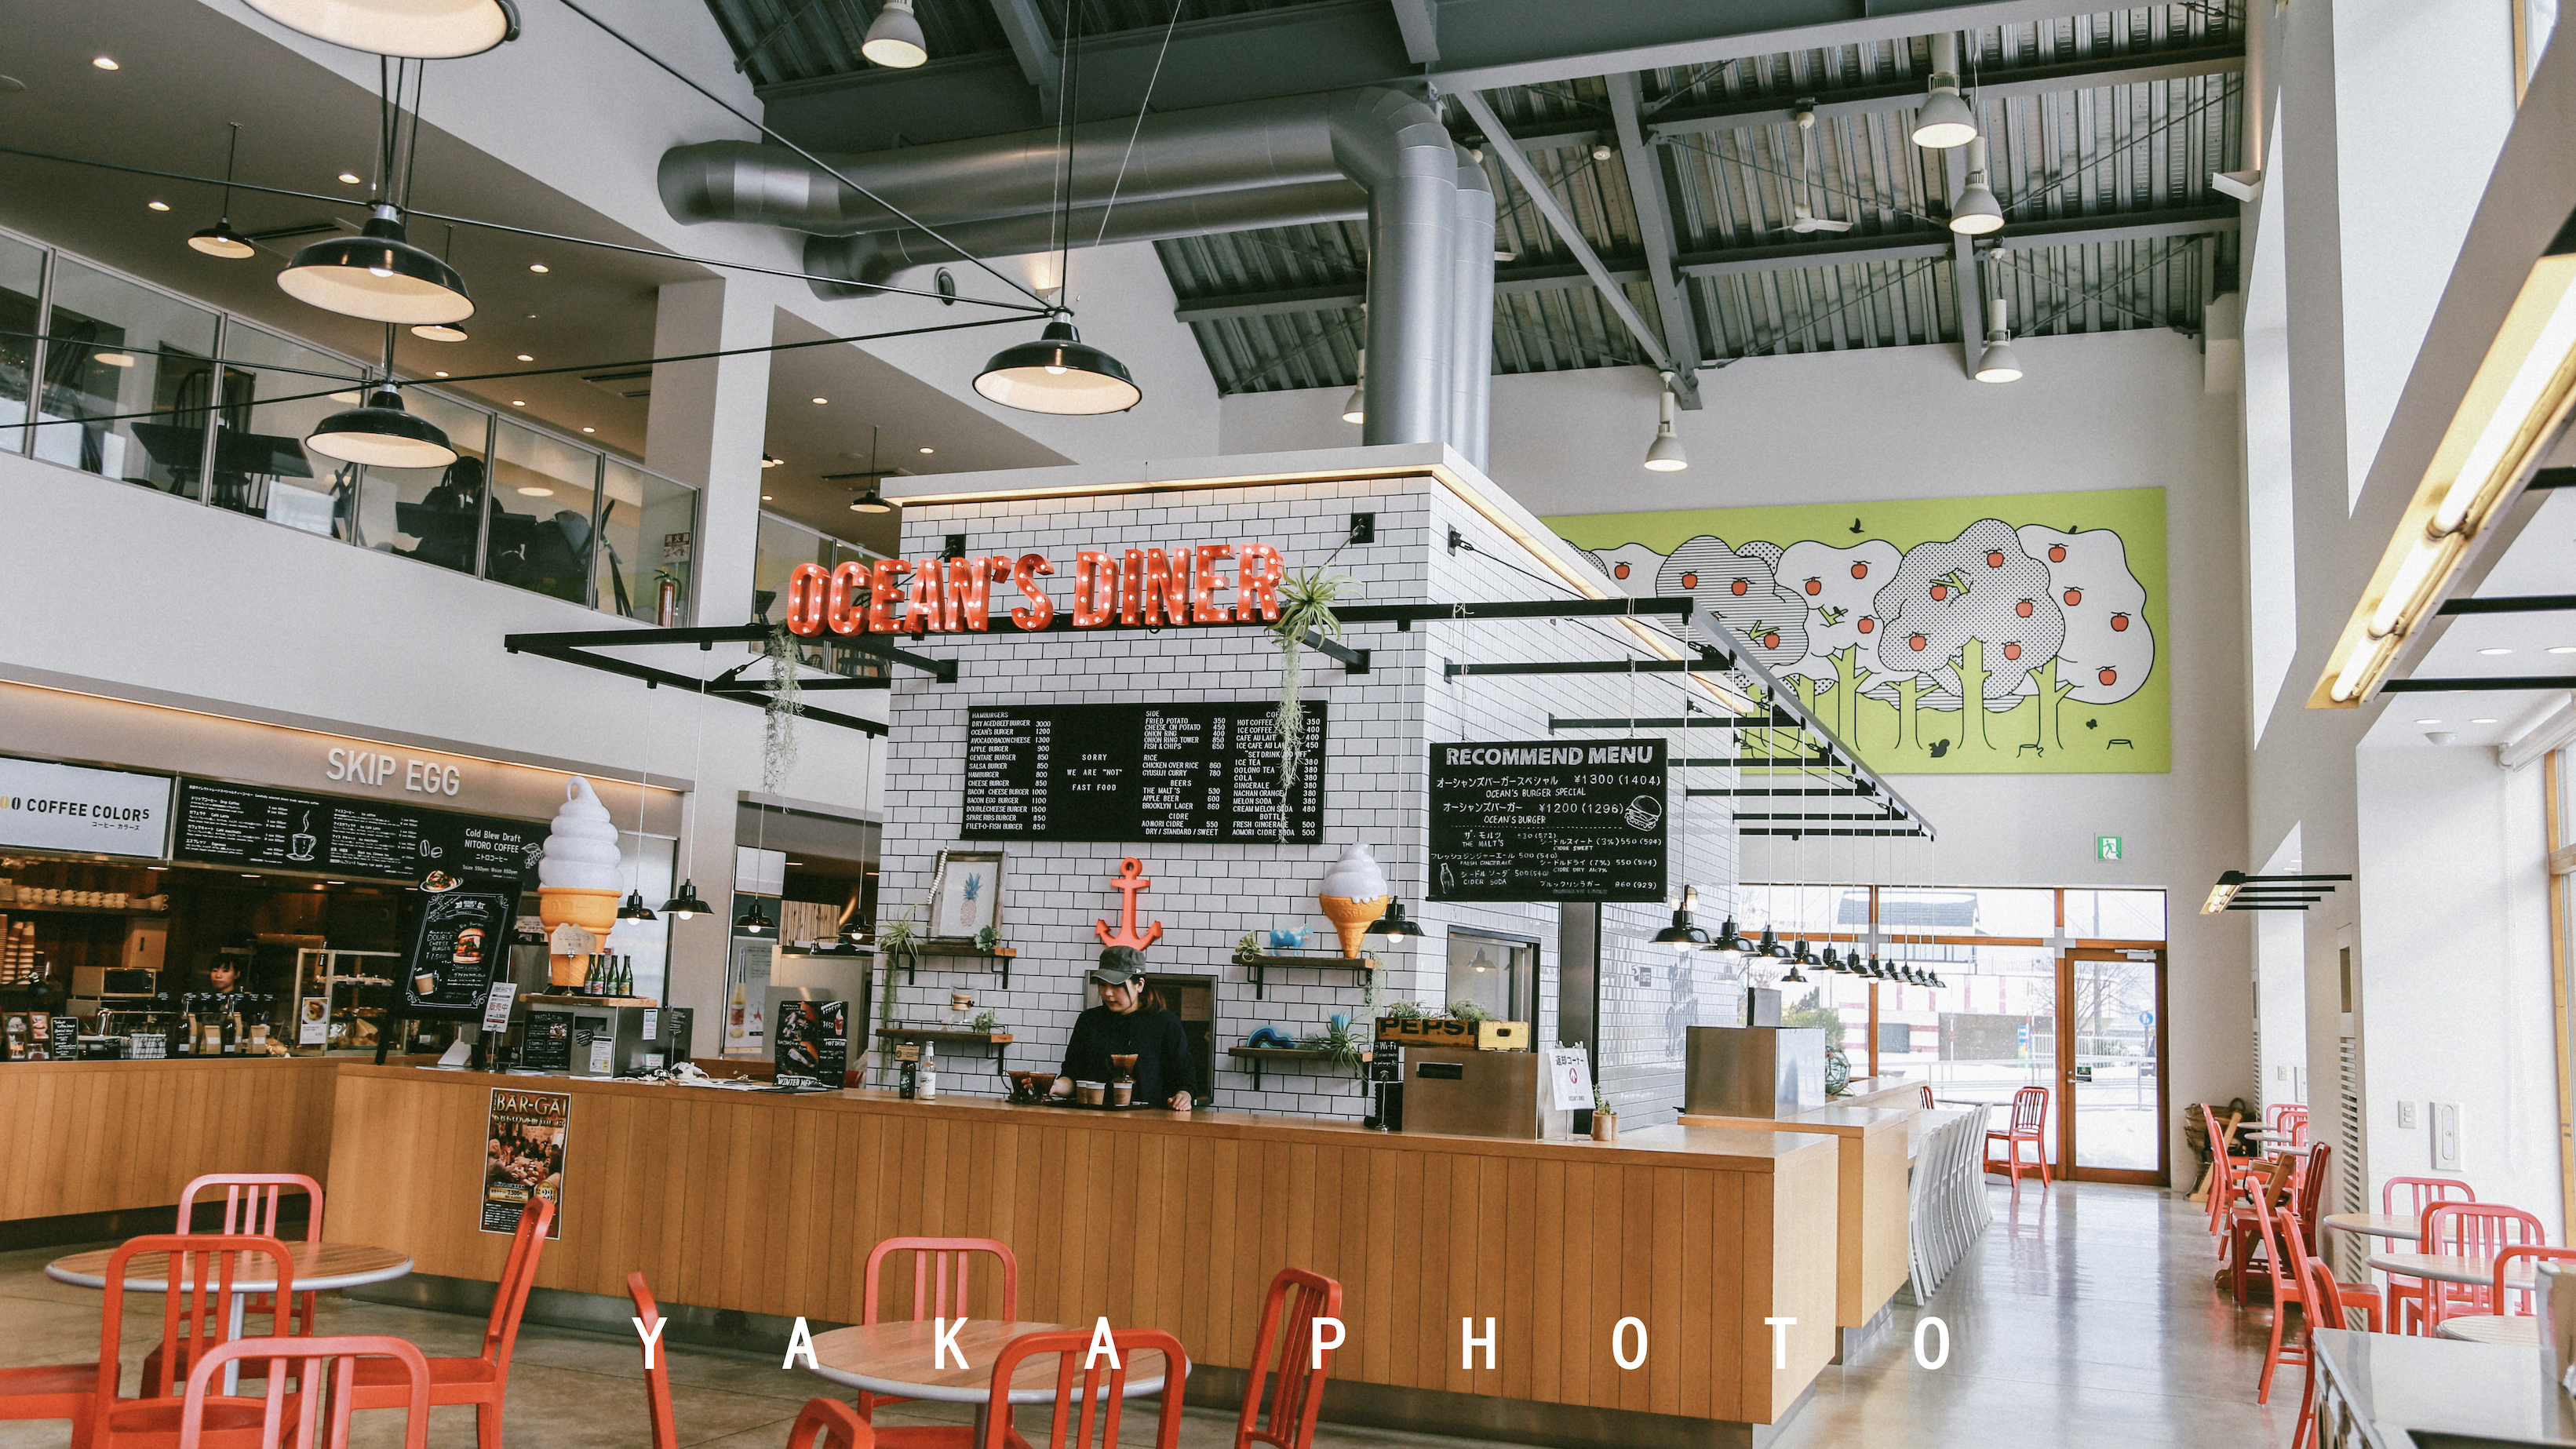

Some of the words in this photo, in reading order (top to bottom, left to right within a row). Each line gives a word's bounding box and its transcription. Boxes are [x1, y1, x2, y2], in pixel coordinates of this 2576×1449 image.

[786, 552, 1054, 637] OCEAN'S
[1072, 543, 1284, 627] DINER
[1446, 748, 1583, 766] RECOMMEND
[1587, 746, 1653, 764] MENU
[326, 748, 396, 786] SKIP
[406, 759, 460, 796] EGG
[1437, 776, 1558, 788] オーシャンズバーガースペシャル
[1573, 774, 1614, 785] ¥1300
[1619, 774, 1661, 786] (1404)
[1485, 788, 1518, 799] OCEAN'S
[1522, 788, 1551, 798] BURGER
[1555, 788, 1587, 796] SPECIAL
[27, 799, 87, 817] COFFEE
[1443, 803, 1522, 813] オーシャンズバーガー
[1539, 803, 1578, 814] ¥1200
[1582, 803, 1624, 814] (1296)
[1484, 815, 1517, 824] OCEAN'S
[465, 828, 481, 838] Cold
[483, 830, 500, 840] Blew
[503, 832, 521, 843] Draft
[465, 839, 491, 850] NITORO
[494, 843, 519, 854] COFFEE
[1540, 837, 1593, 846] シードルスイート
[475, 854, 508, 862] ニトロコーヒー
[1634, 858, 1657, 867] (594)
[1633, 881, 1656, 890] (929)
[489, 1002, 508, 1011] 販売中
[1381, 1020, 1475, 1036] PEPSI
[1379, 1041, 1396, 1050] Wi-Fi
[1555, 1055, 1584, 1065] 返却コーナー
[778, 1077, 800, 1086] WINTER
[496, 1093, 567, 1116] BAR-GAI
